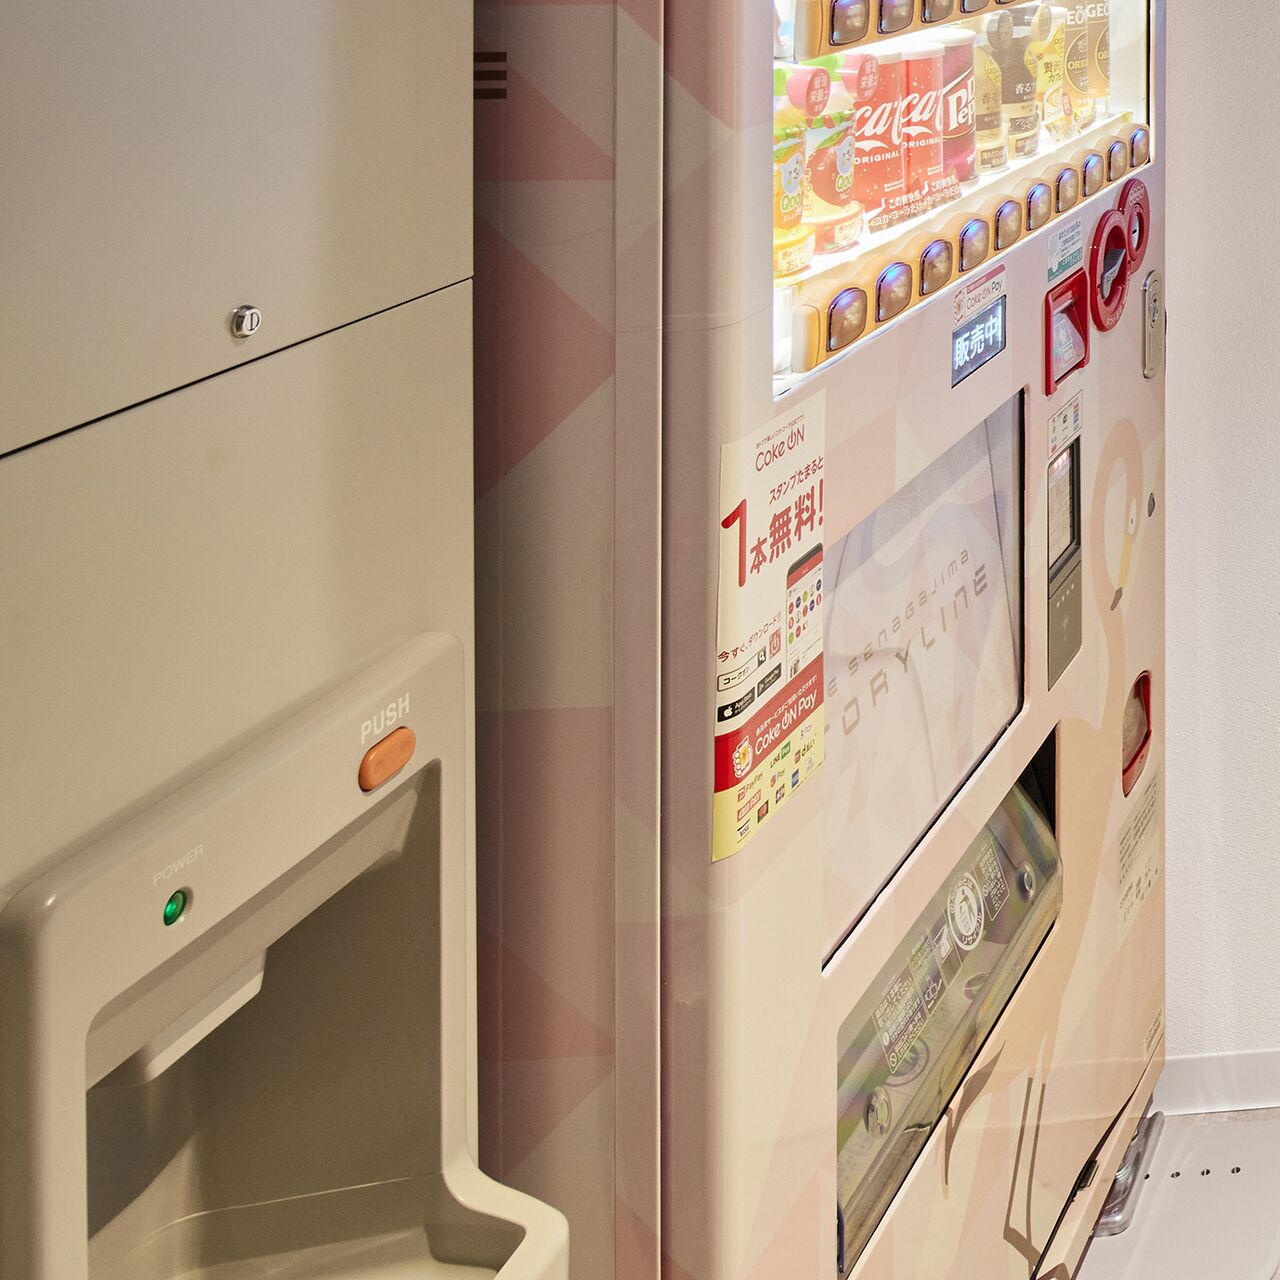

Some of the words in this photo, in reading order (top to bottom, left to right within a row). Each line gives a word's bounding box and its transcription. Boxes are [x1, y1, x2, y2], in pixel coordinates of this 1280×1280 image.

[853, 150, 901, 166] ORIGINAL
[954, 314, 998, 371] 販売中
[755, 440, 786, 472] Coke
[786, 424, 805, 450] ON
[769, 455, 824, 505] スタンプたまると
[360, 692, 412, 746] PUSH
[754, 721, 781, 756] Coke
[781, 707, 798, 731] ON
[798, 689, 818, 717] Pay
[152, 843, 205, 887] POWER
